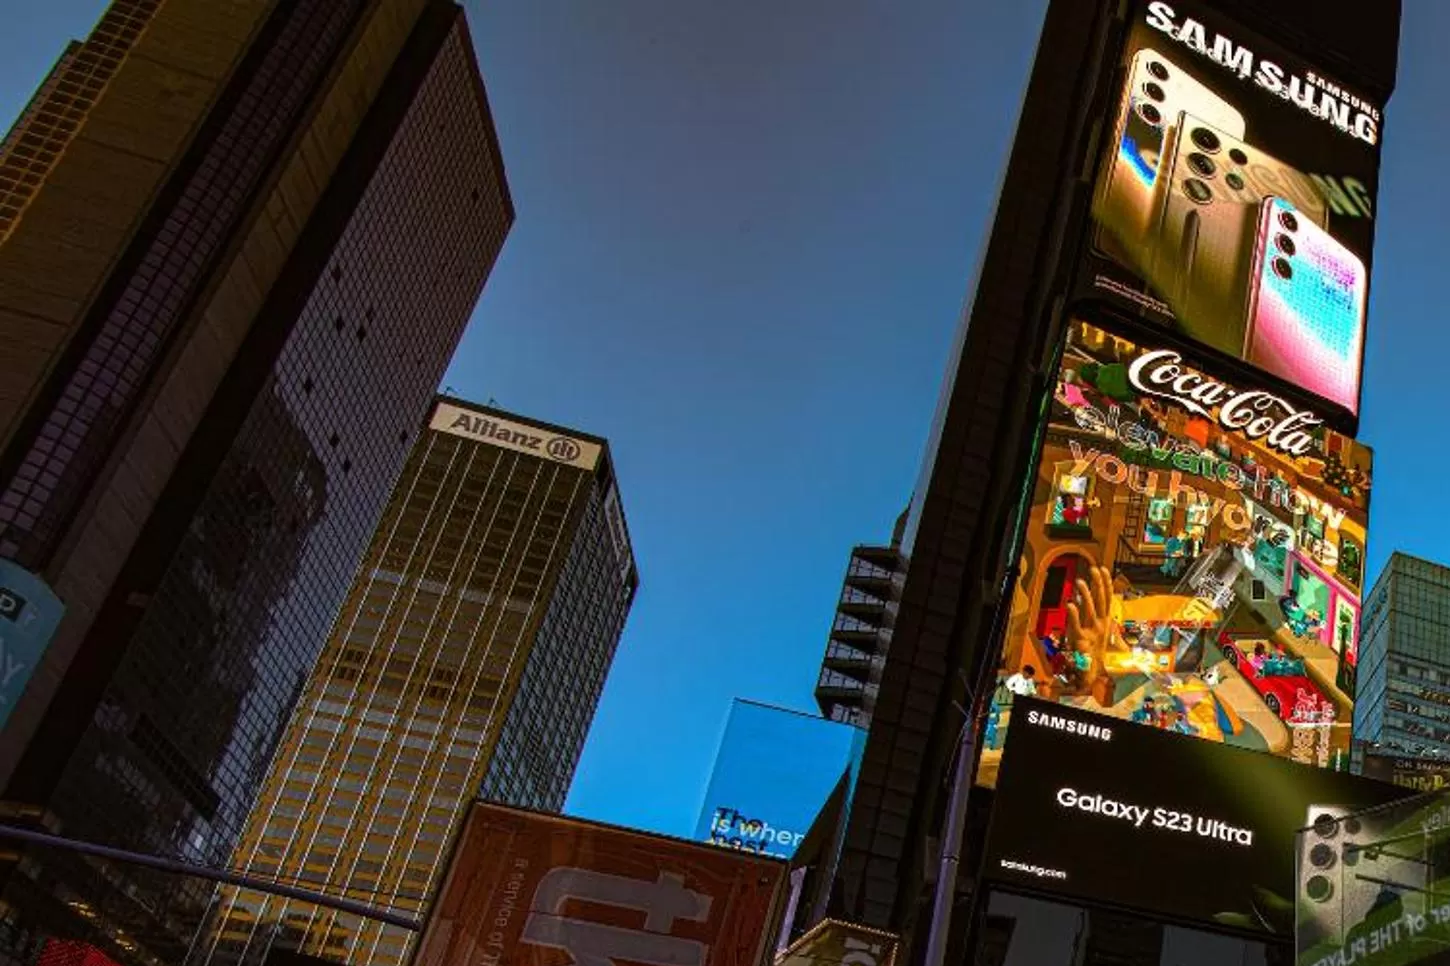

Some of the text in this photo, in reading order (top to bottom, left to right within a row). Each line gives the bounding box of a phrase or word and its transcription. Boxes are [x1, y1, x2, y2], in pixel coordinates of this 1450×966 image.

[1146, 1, 1380, 146] SAMSUNG
[1305, 72, 1381, 122] SAMSUNG
[450, 413, 542, 450] Allianz
[1028, 710, 1112, 742] SAMSUNG
[1057, 788, 1253, 846] Galaxy S23 Ultra
